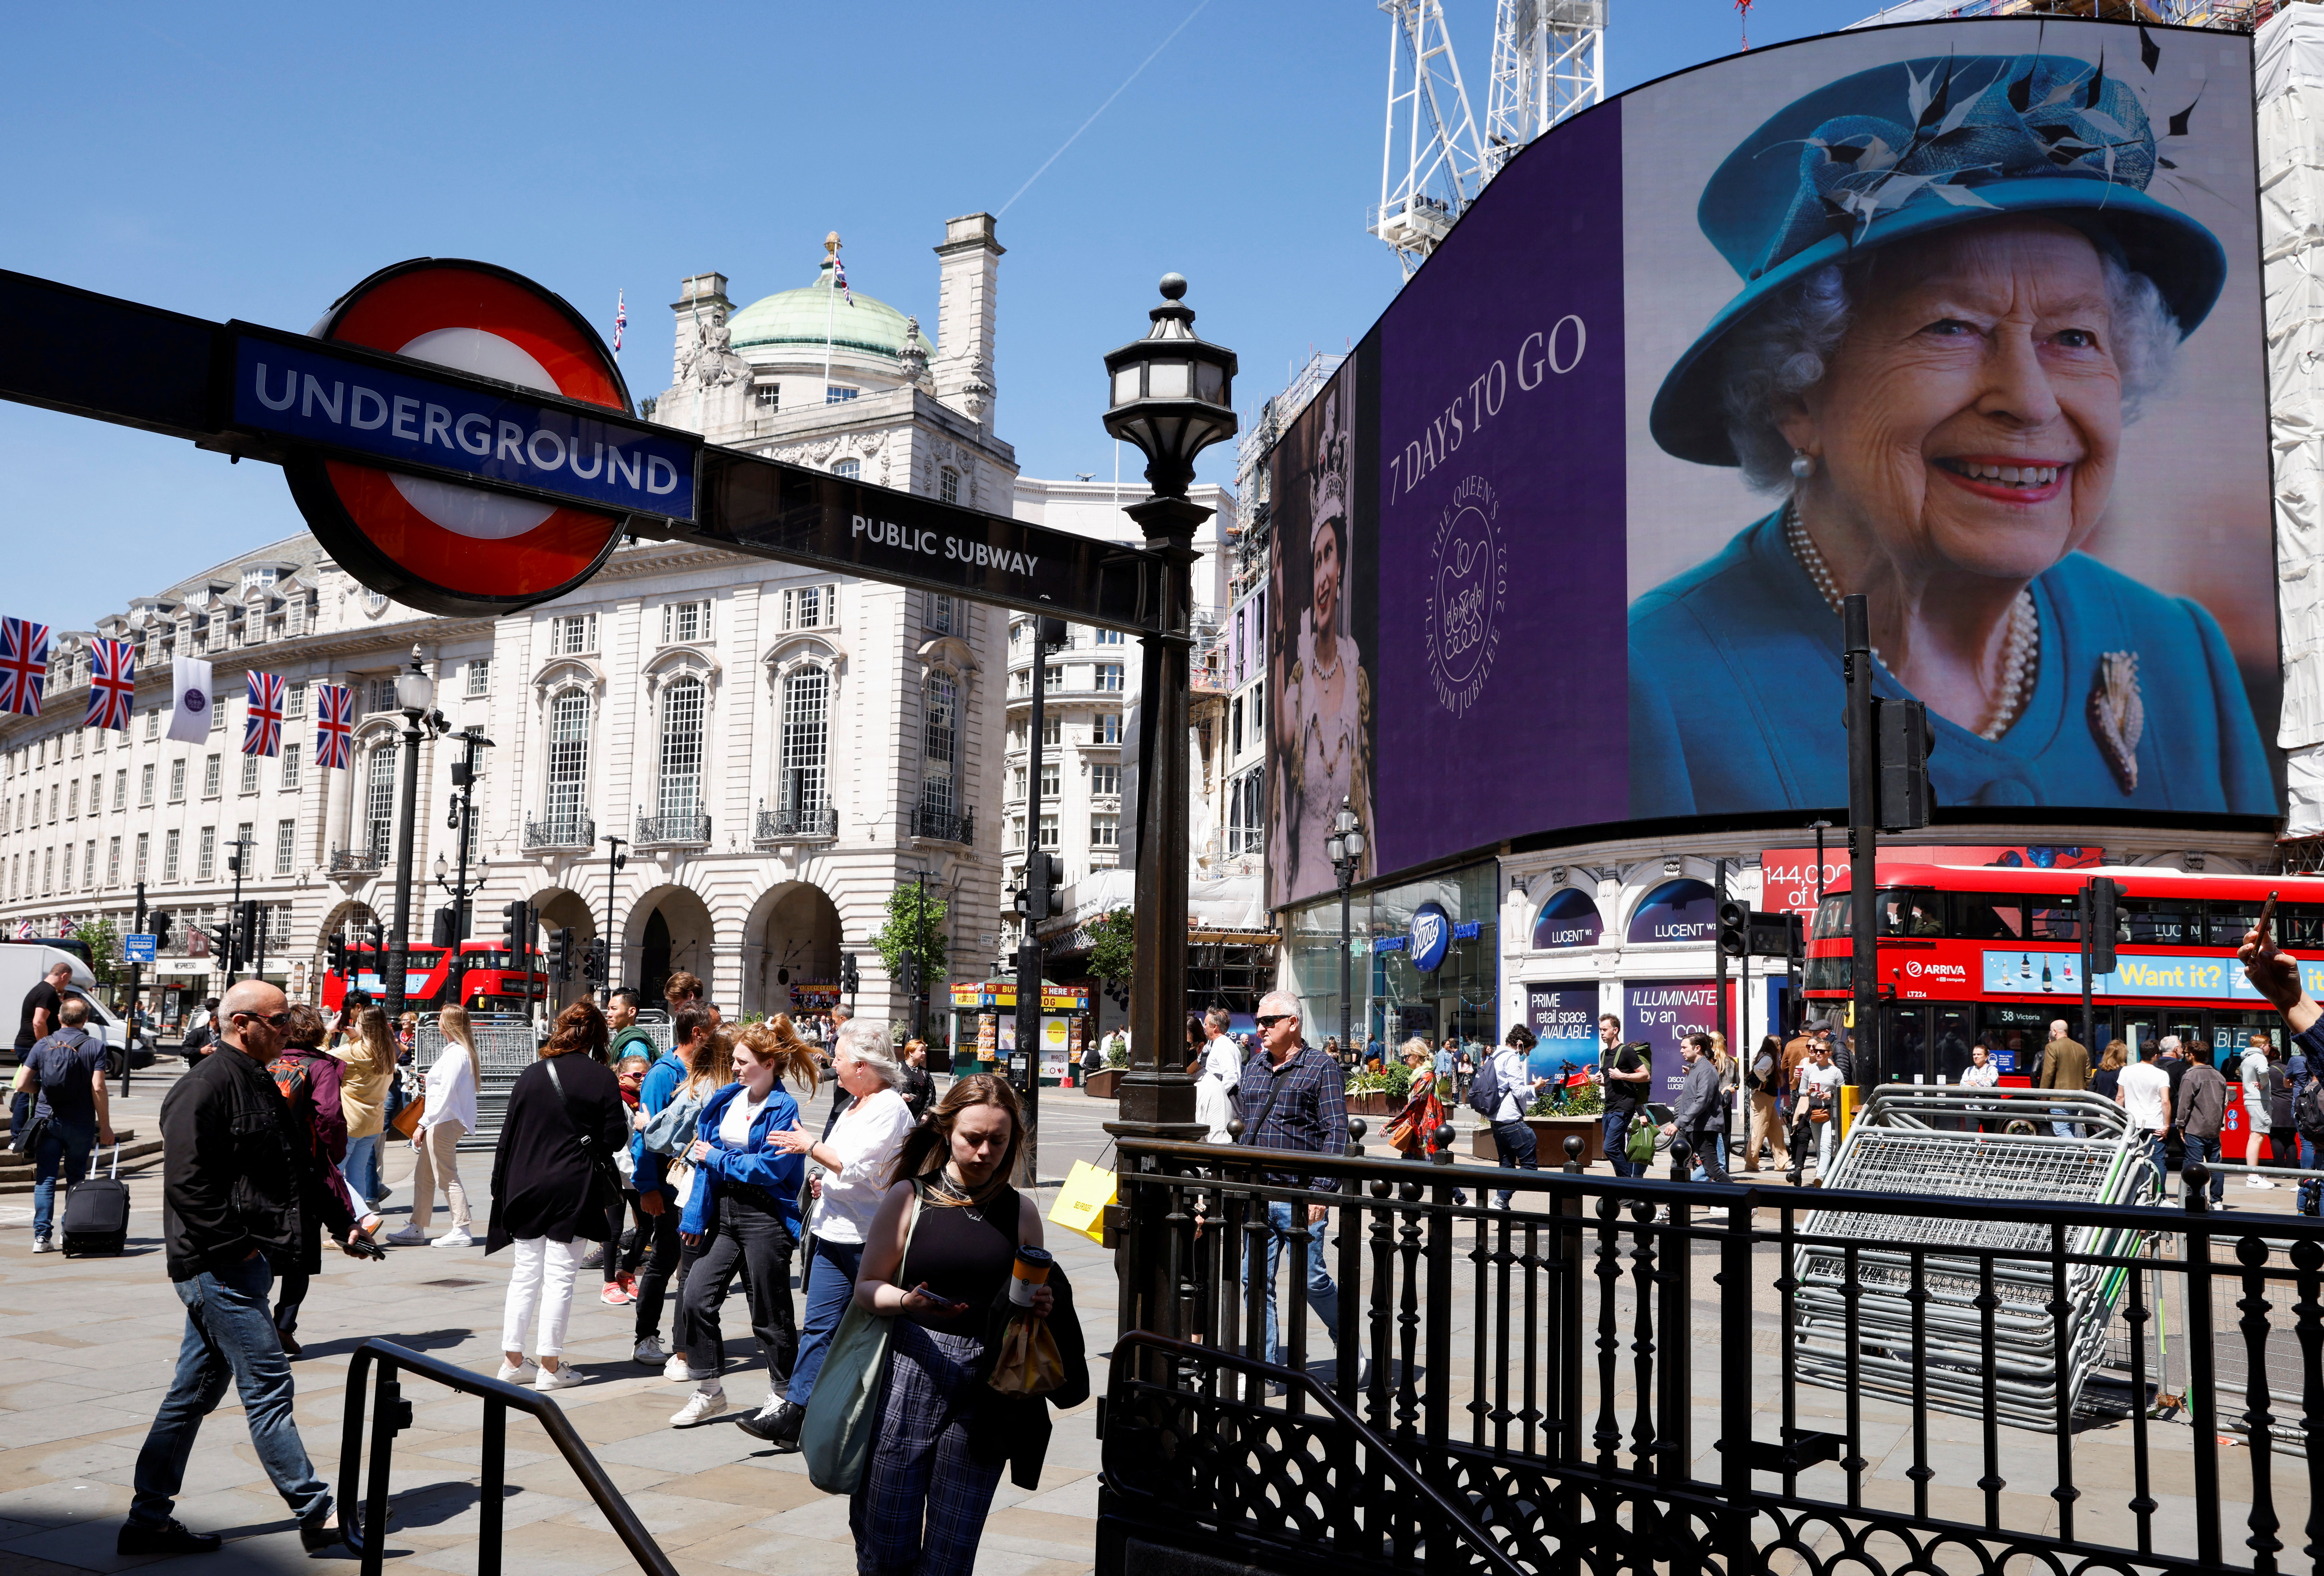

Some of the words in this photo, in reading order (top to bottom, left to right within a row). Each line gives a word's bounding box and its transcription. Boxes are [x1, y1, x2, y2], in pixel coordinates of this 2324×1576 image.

[1391, 455, 1400, 506] 7
[1405, 396, 1463, 494] DAYS
[1469, 360, 1506, 433] TO
[1517, 314, 1586, 391] GO
[256, 363, 678, 495] UNDERGROUND
[1431, 505, 1451, 559] THE
[852, 514, 937, 555] PUBLIC
[944, 536, 1039, 577] SUBWAY
[1425, 596, 1455, 713] PLATINUM
[1458, 626, 1500, 719] JUBILEE
[1496, 543, 1507, 613] 2022
[727, 845, 780, 854] ALLIANCE
[912, 844, 931, 852] COUNTY
[964, 853, 979, 862] OFFICE
[1789, 887, 1808, 906] of
[1411, 913, 1440, 960] Boots
[1454, 919, 1481, 940] beauty
[1552, 929, 1584, 943] LUCENT
[1655, 923, 1704, 937] LUCENT
[1375, 936, 1406, 956] pharmacy
[174, 961, 196, 971] NESPRESSO
[248, 961, 274, 970] NESESSO
[1924, 964, 1966, 975] ARRIVA
[2117, 964, 2185, 987] Want
[2190, 965, 2221, 988] it?
[1041, 997, 1056, 1006] OG
[1532, 993, 1560, 1008] PRIME
[1633, 990, 1717, 1006] ILLUMINATE
[1536, 1010, 1556, 1024] retail
[1558, 1012, 1587, 1026] space
[1641, 1008, 1656, 1026] by
[1660, 1011, 1676, 1023] an
[2002, 1011, 2014, 1021] 38
[1540, 1024, 1592, 1039] AVAILABLE
[1074, 1201, 1092, 1212] SELFRIDGES
